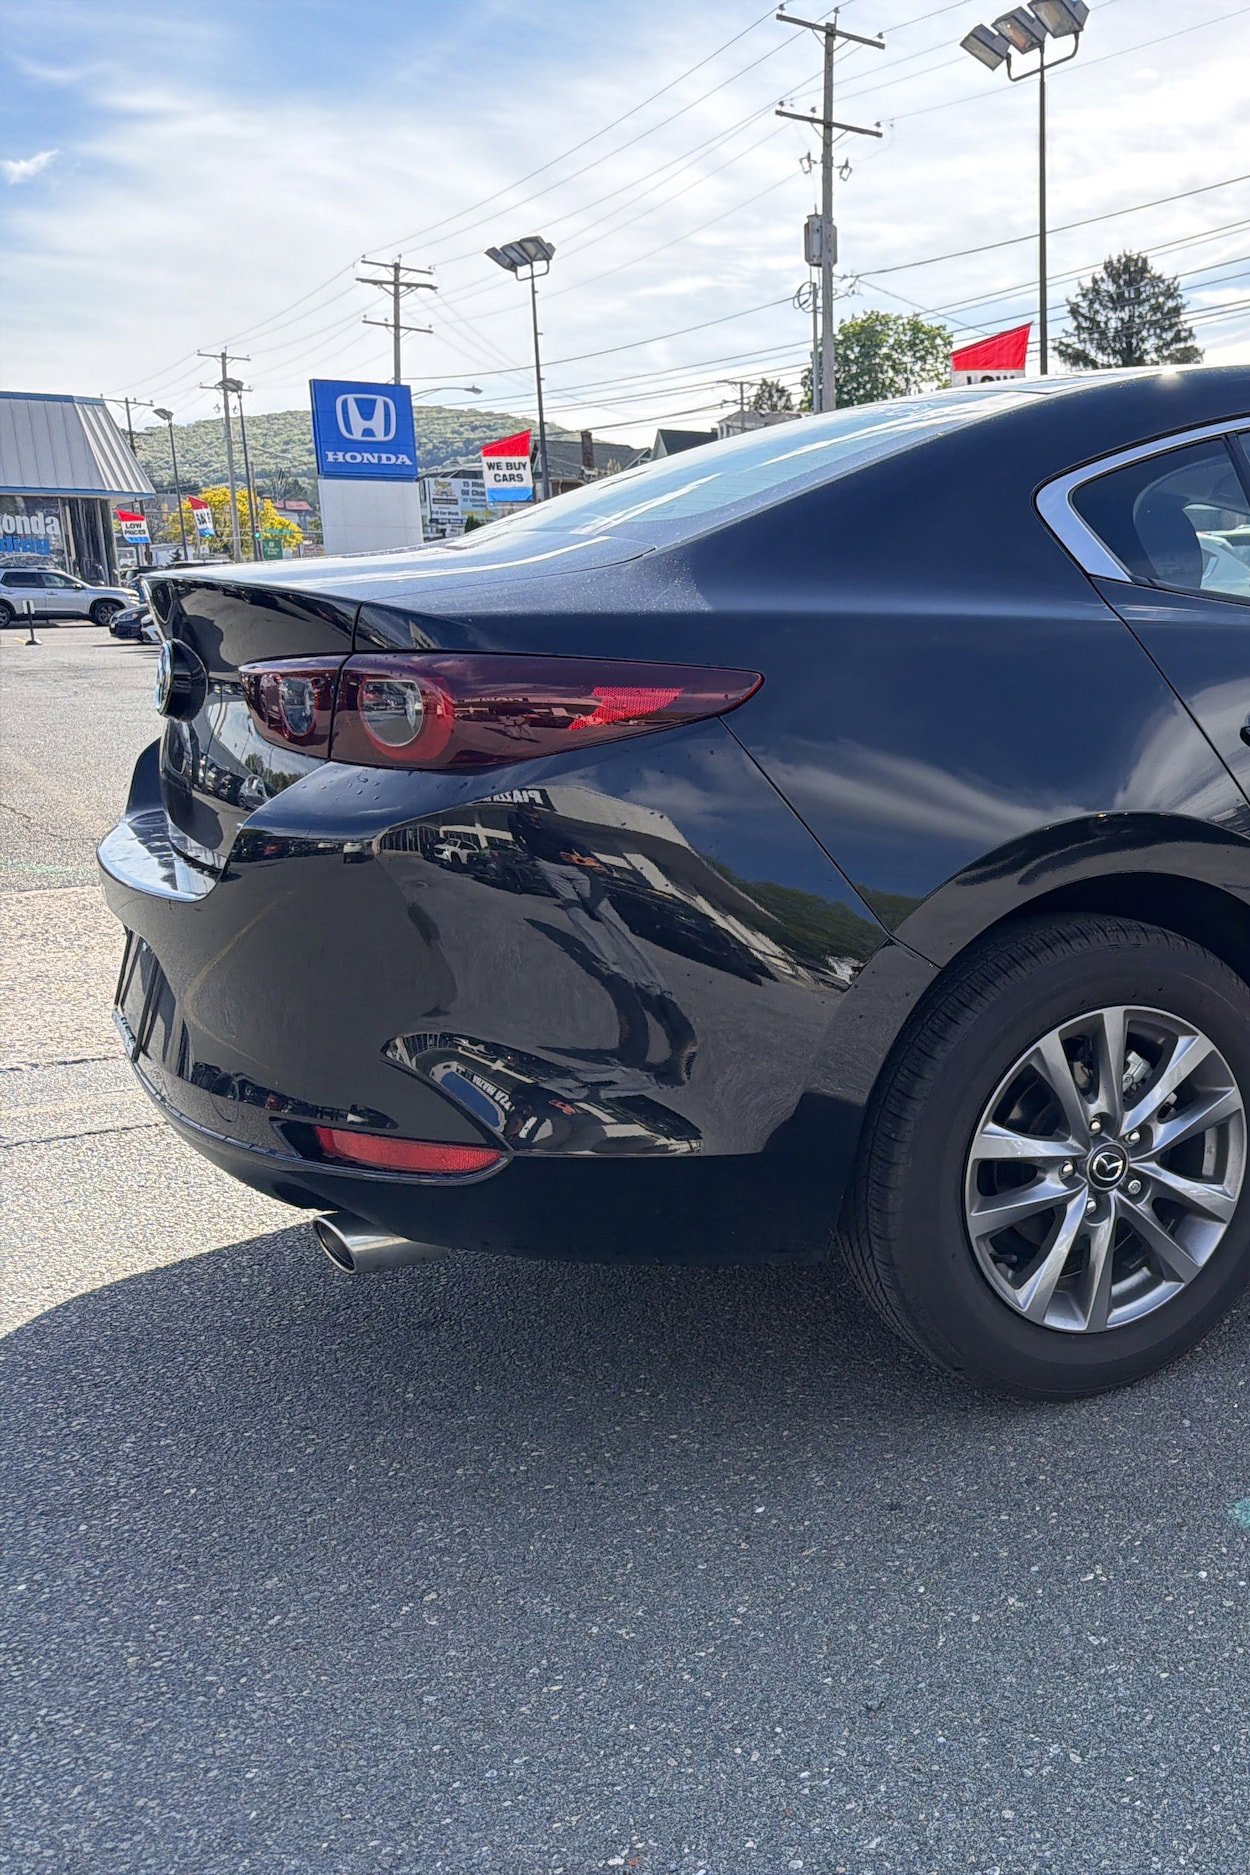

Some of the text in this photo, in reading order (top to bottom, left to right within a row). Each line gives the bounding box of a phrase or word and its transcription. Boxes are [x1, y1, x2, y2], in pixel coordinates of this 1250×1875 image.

[325, 451, 413, 465] HONDA
[486, 461, 527, 471] WE BUY
[493, 473, 524, 483] CARS
[0, 512, 61, 535] onda
